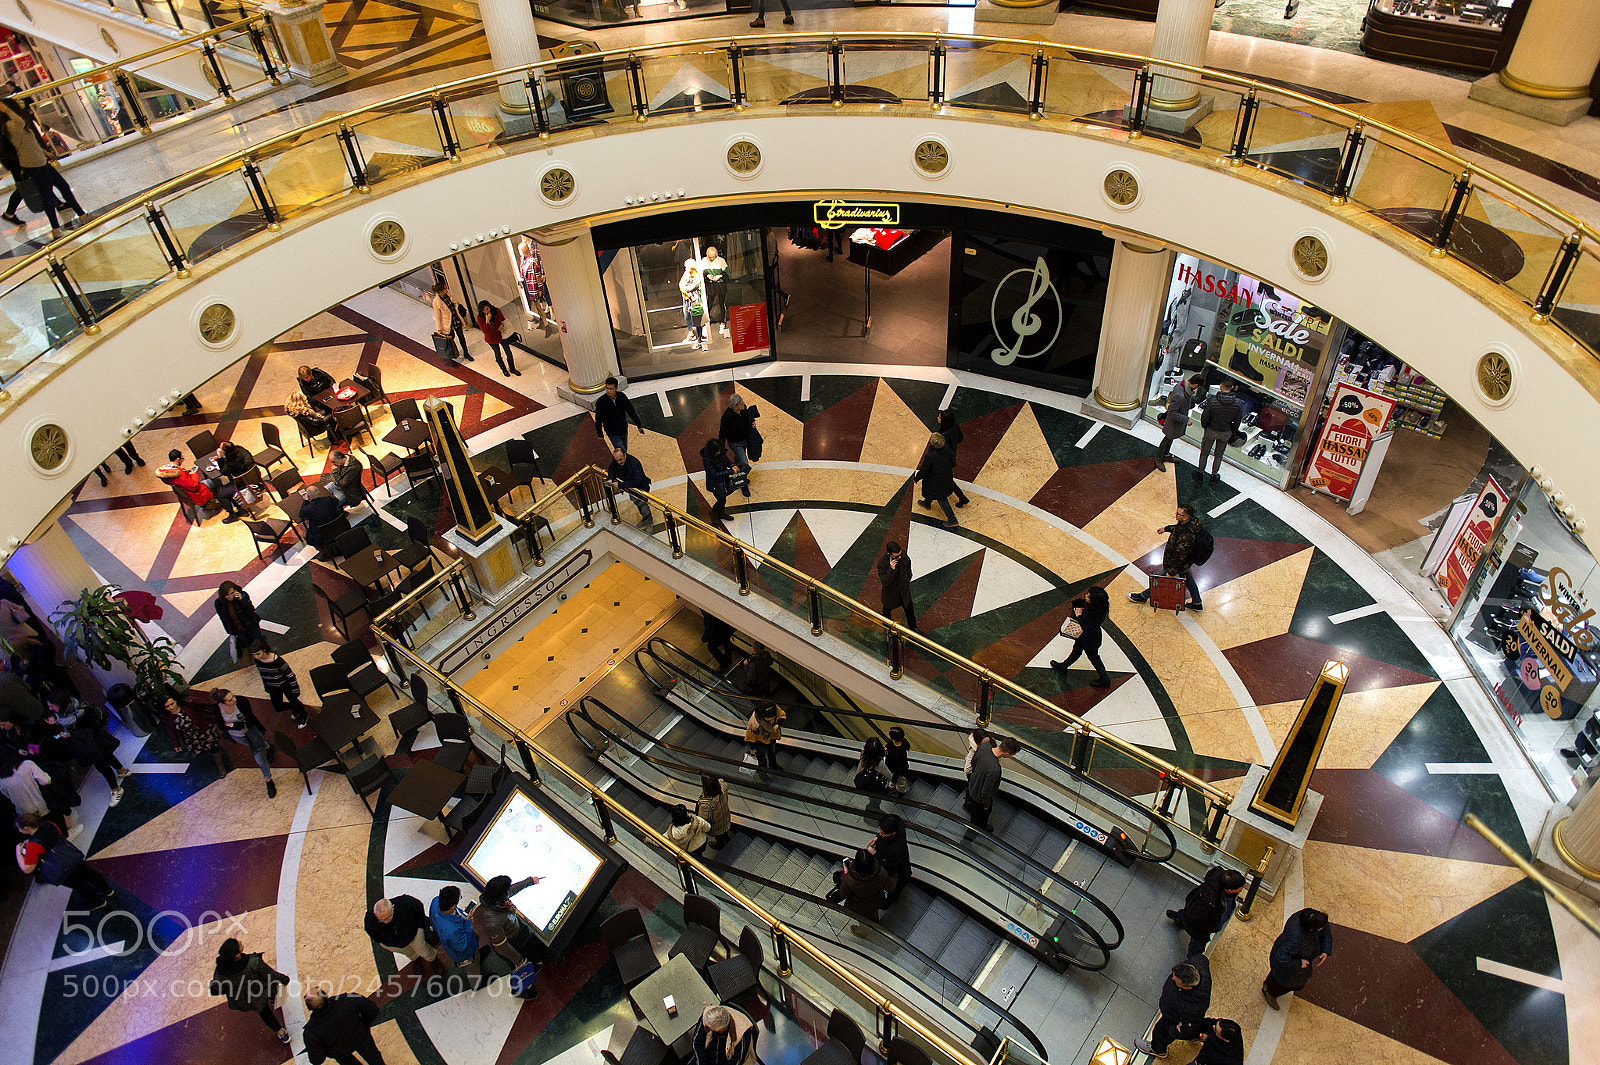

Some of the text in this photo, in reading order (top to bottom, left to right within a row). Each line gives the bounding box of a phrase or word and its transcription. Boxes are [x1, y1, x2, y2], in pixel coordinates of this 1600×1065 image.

[826, 203, 892, 224] Stradivarius
[1177, 263, 1253, 309] HASSAN
[1254, 298, 1310, 345] Sale
[1248, 342, 1299, 371] INVERNALI
[1250, 328, 1304, 361] SALDI
[1341, 401, 1359, 409] -50%
[1334, 433, 1362, 447] FUORI
[1330, 452, 1357, 467] TUTTO
[1312, 478, 1326, 488] SALE
[1539, 567, 1596, 651] Sale
[1558, 582, 1580, 612] WINTER
[464, 580, 555, 655] INGRESSO
[1505, 635, 1518, 652] 20
[1521, 622, 1565, 682] INVERNALI
[1540, 622, 1575, 660] SALDI
[1525, 663, 1537, 680] 30
[1493, 682, 1523, 727] HASSAN
[1545, 691, 1558, 709] 50
